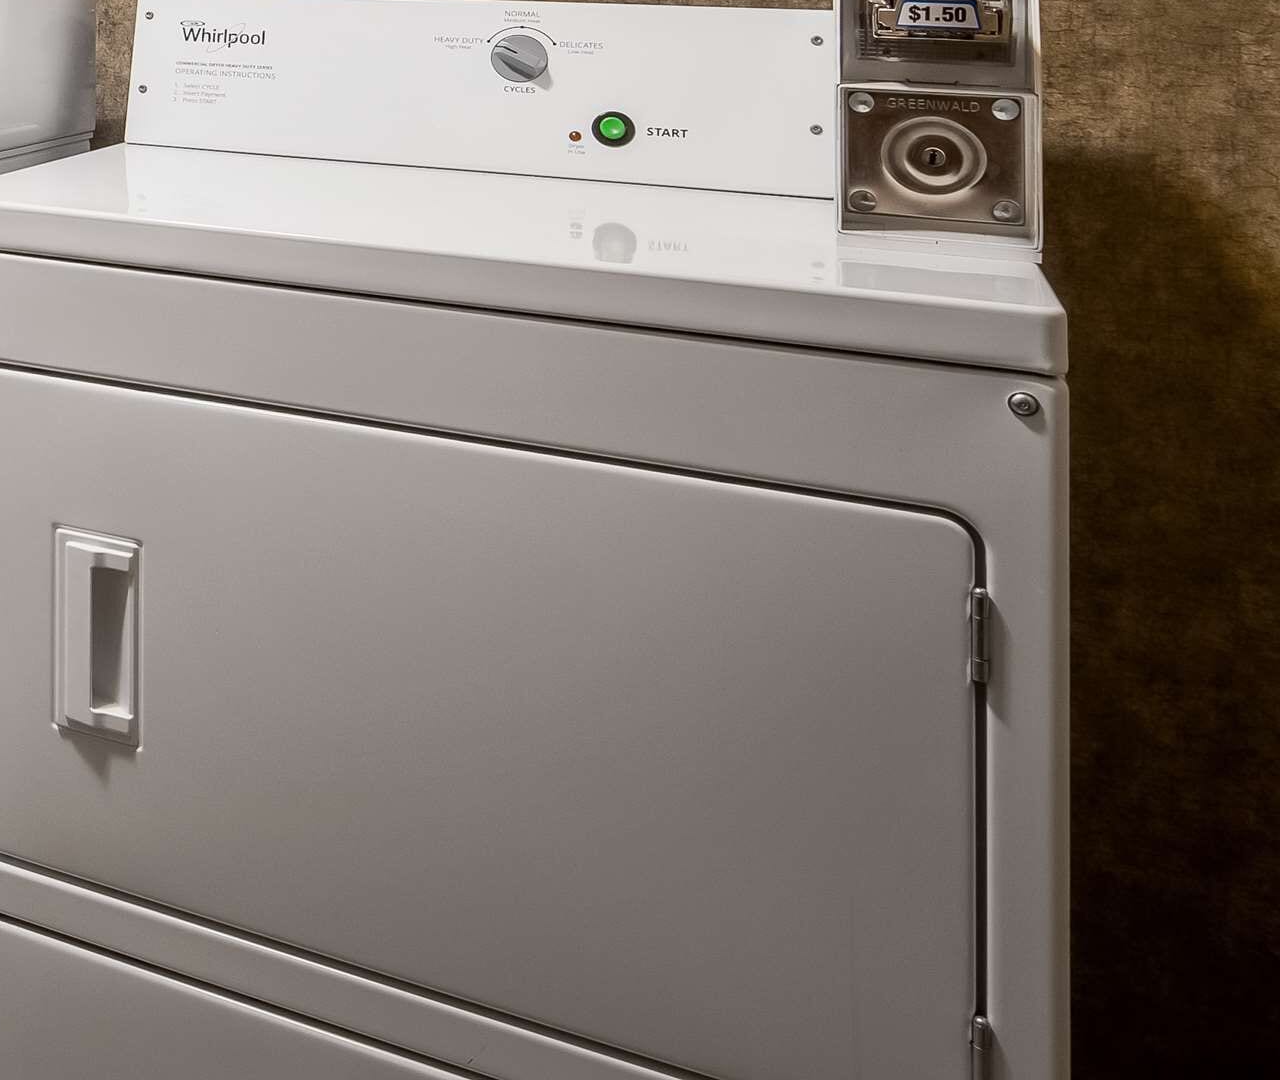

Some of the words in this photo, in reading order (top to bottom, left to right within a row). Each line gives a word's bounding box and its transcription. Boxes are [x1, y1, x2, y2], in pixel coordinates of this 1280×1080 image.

[504, 10, 540, 18] NORMAL
[909, 5, 967, 23] $1.50
[183, 27, 266, 48] Whirlpool
[434, 36, 461, 44] HEAVY
[462, 37, 484, 45] DUTY
[559, 41, 603, 50] DELICATES
[175, 68, 217, 77] OPERATING
[220, 70, 276, 80] INSTRUCTIONS
[504, 85, 536, 94] CYCLES
[887, 98, 980, 113] GREENWALD
[646, 127, 688, 139] START
